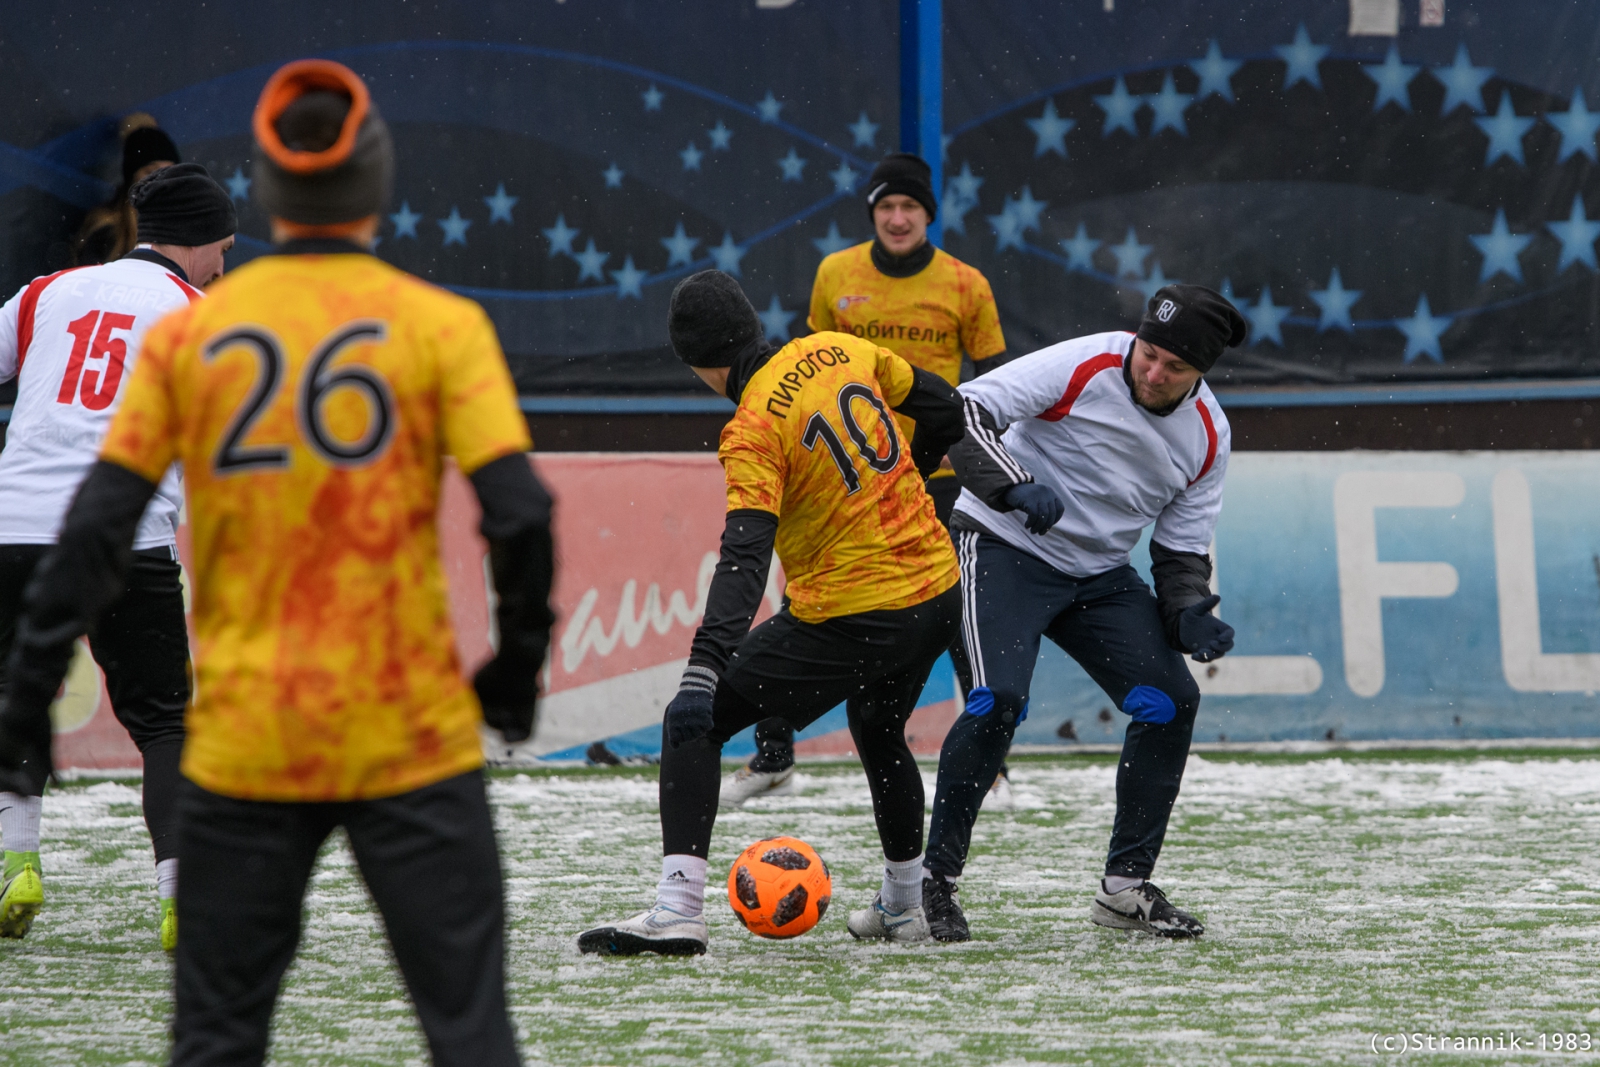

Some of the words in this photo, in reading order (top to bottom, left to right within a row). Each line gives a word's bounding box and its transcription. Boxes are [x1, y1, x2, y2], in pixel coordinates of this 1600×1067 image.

[58, 277, 91, 297] FC
[94, 282, 177, 313] KAMAZ
[56, 309, 136, 411] 15
[200, 319, 397, 475] 26
[766, 346, 850, 419] ПИРОГОВ
[801, 382, 900, 497] 10
